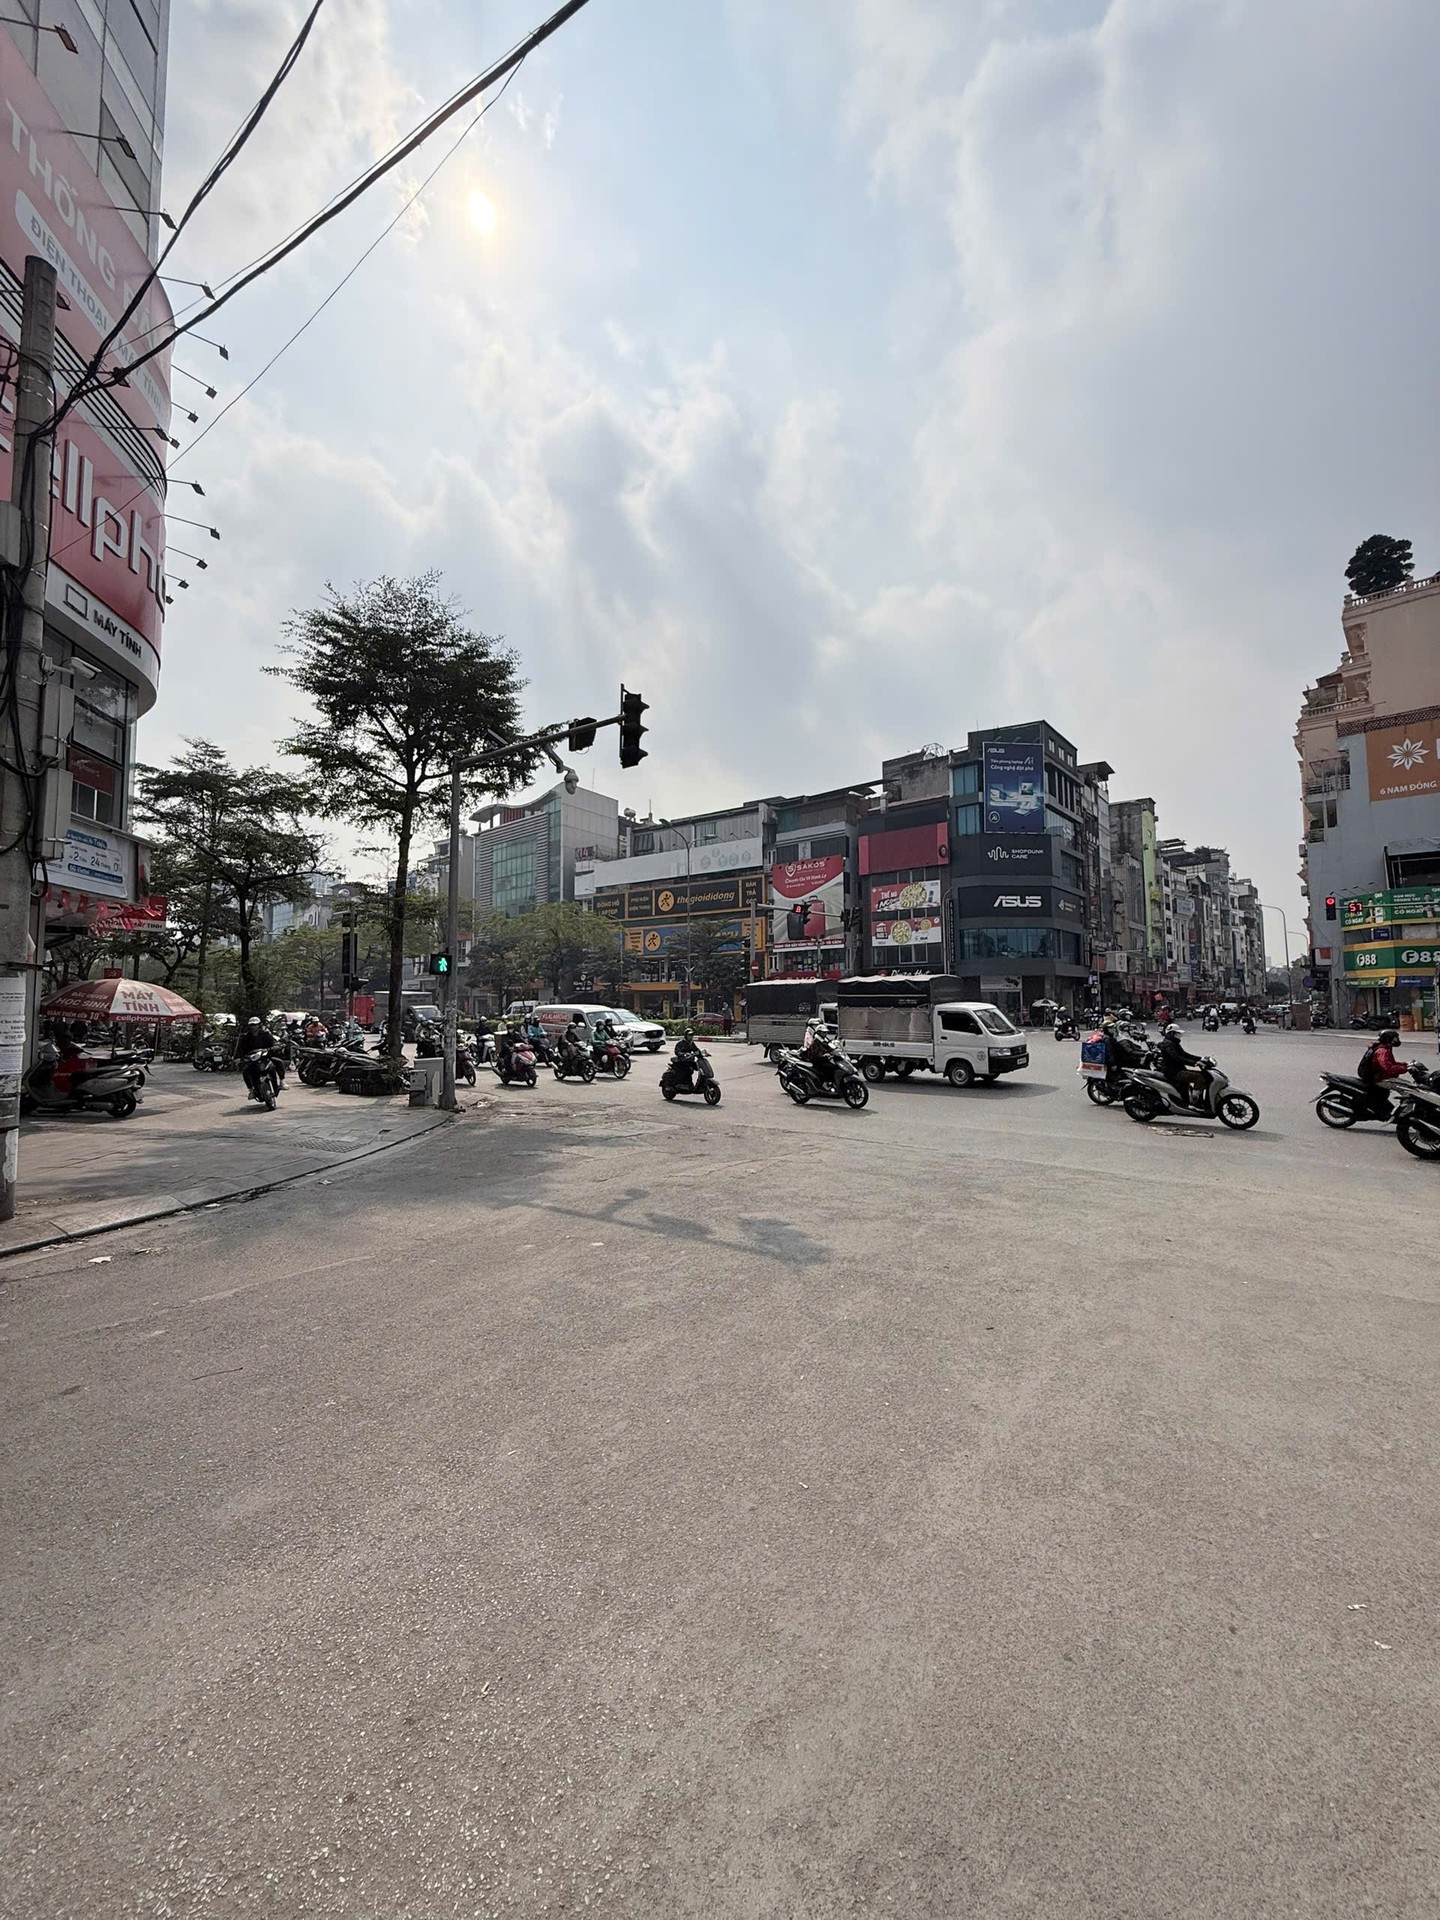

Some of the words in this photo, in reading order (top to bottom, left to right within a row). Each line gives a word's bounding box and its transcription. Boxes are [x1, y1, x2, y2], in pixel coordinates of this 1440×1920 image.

[31, 215, 66, 275] ĐIỆN
[69, 266, 108, 331] THOẠI
[93, 609, 118, 637] MÁY
[119, 629, 142, 658] TÍNH
[1387, 785, 1408, 794] NAM
[797, 861, 825, 870] SAKOS
[993, 896, 1042, 907] ASUS
[1349, 903, 1363, 912] 57
[1357, 953, 1376, 966] F88
[121, 989, 154, 1001] MÁY
[81, 1000, 109, 1009] SINH
[122, 1000, 160, 1013] TÍNH
